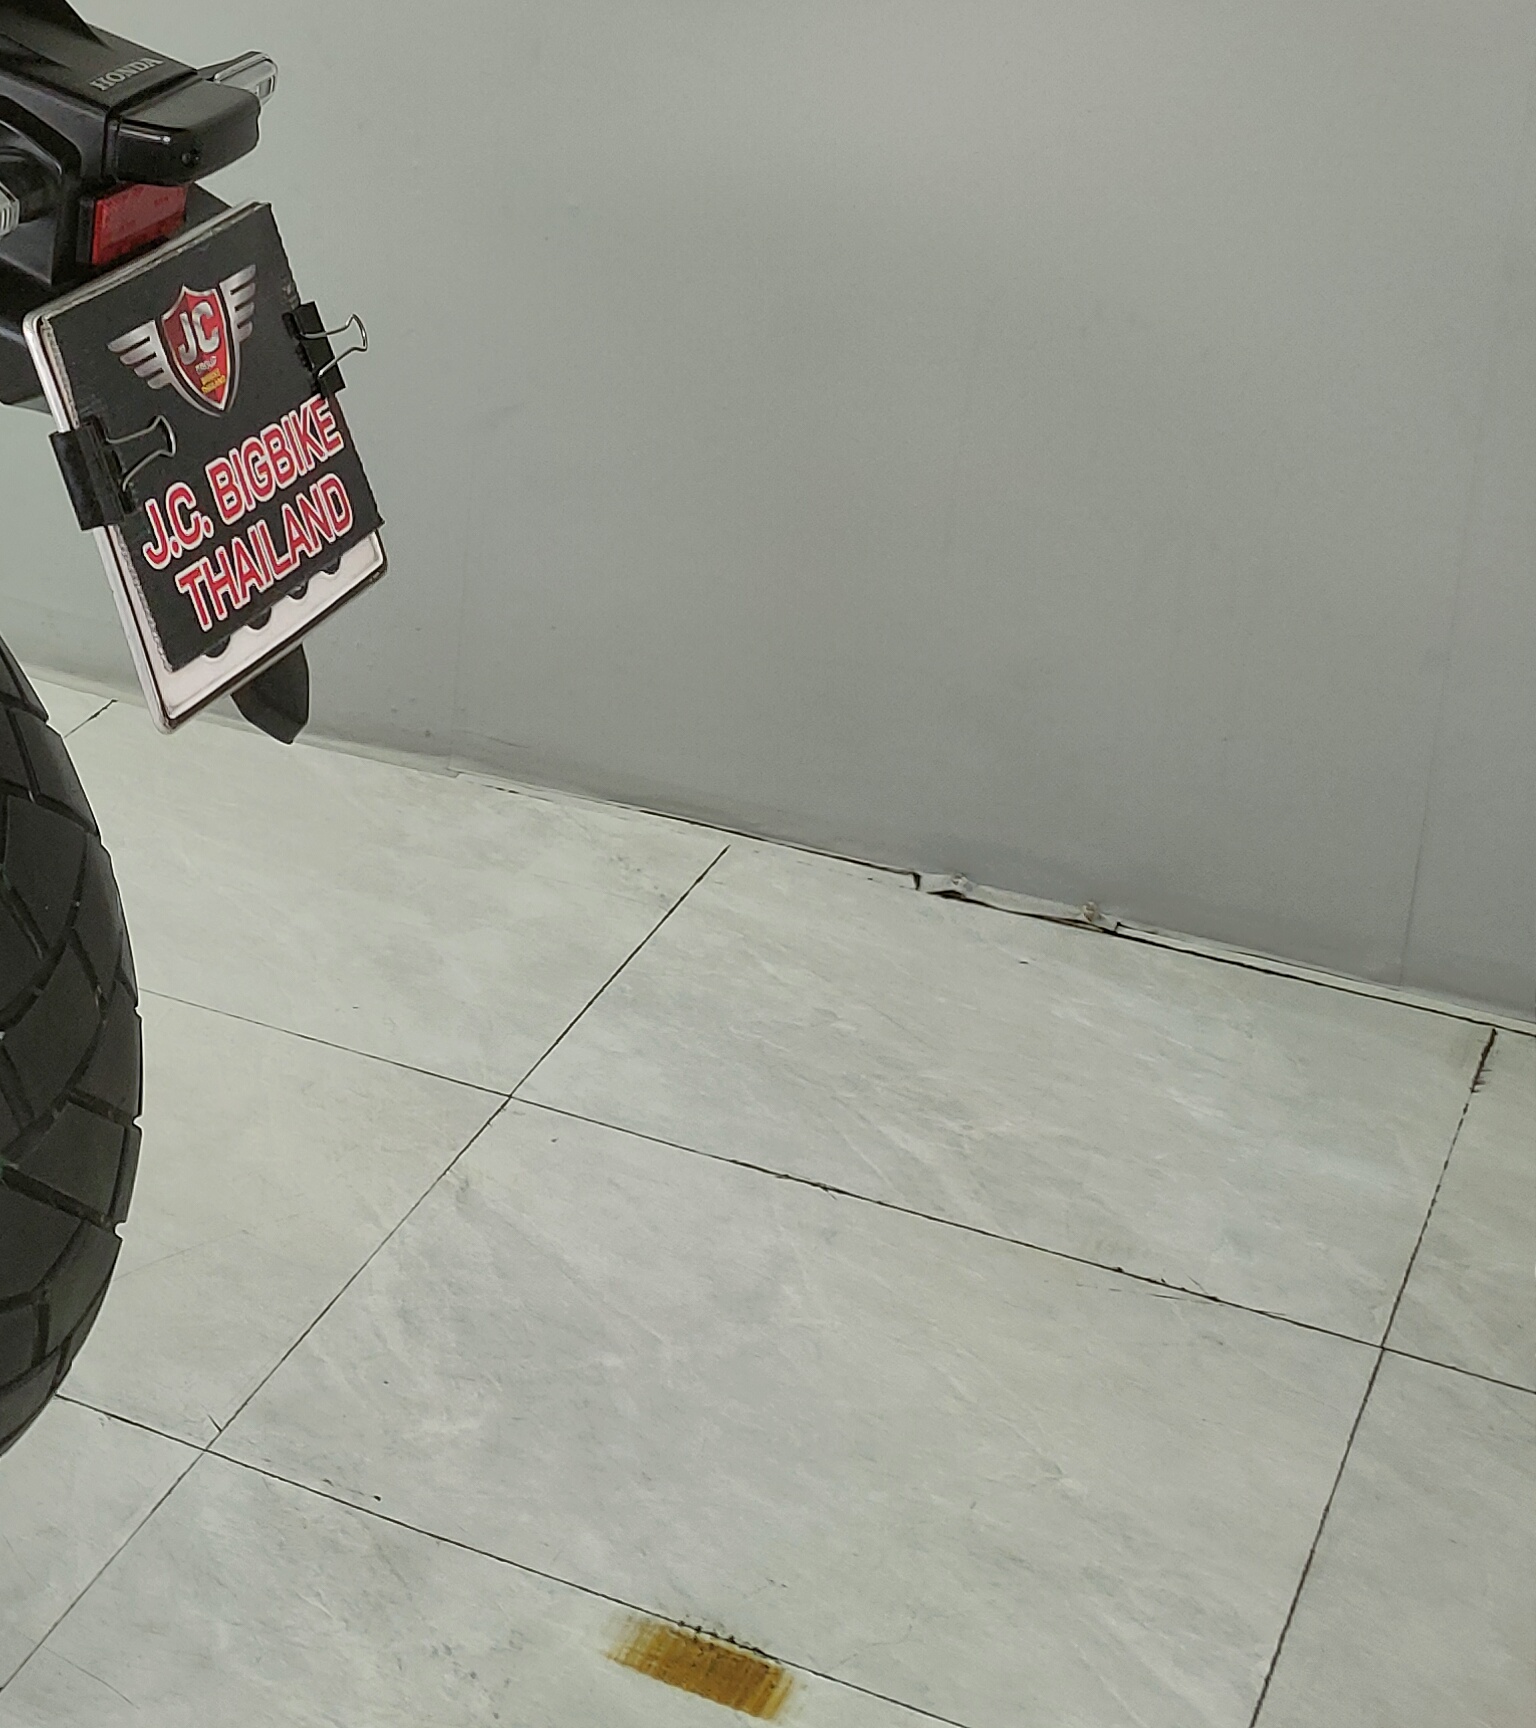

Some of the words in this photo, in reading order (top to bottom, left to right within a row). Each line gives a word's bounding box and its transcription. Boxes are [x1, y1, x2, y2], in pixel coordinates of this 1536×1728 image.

[88, 56, 165, 92] HONDA
[177, 300, 221, 366] JC
[141, 480, 214, 571] J.C.
[204, 392, 345, 527] BIGBIKE
[176, 472, 356, 633] THAILAND
